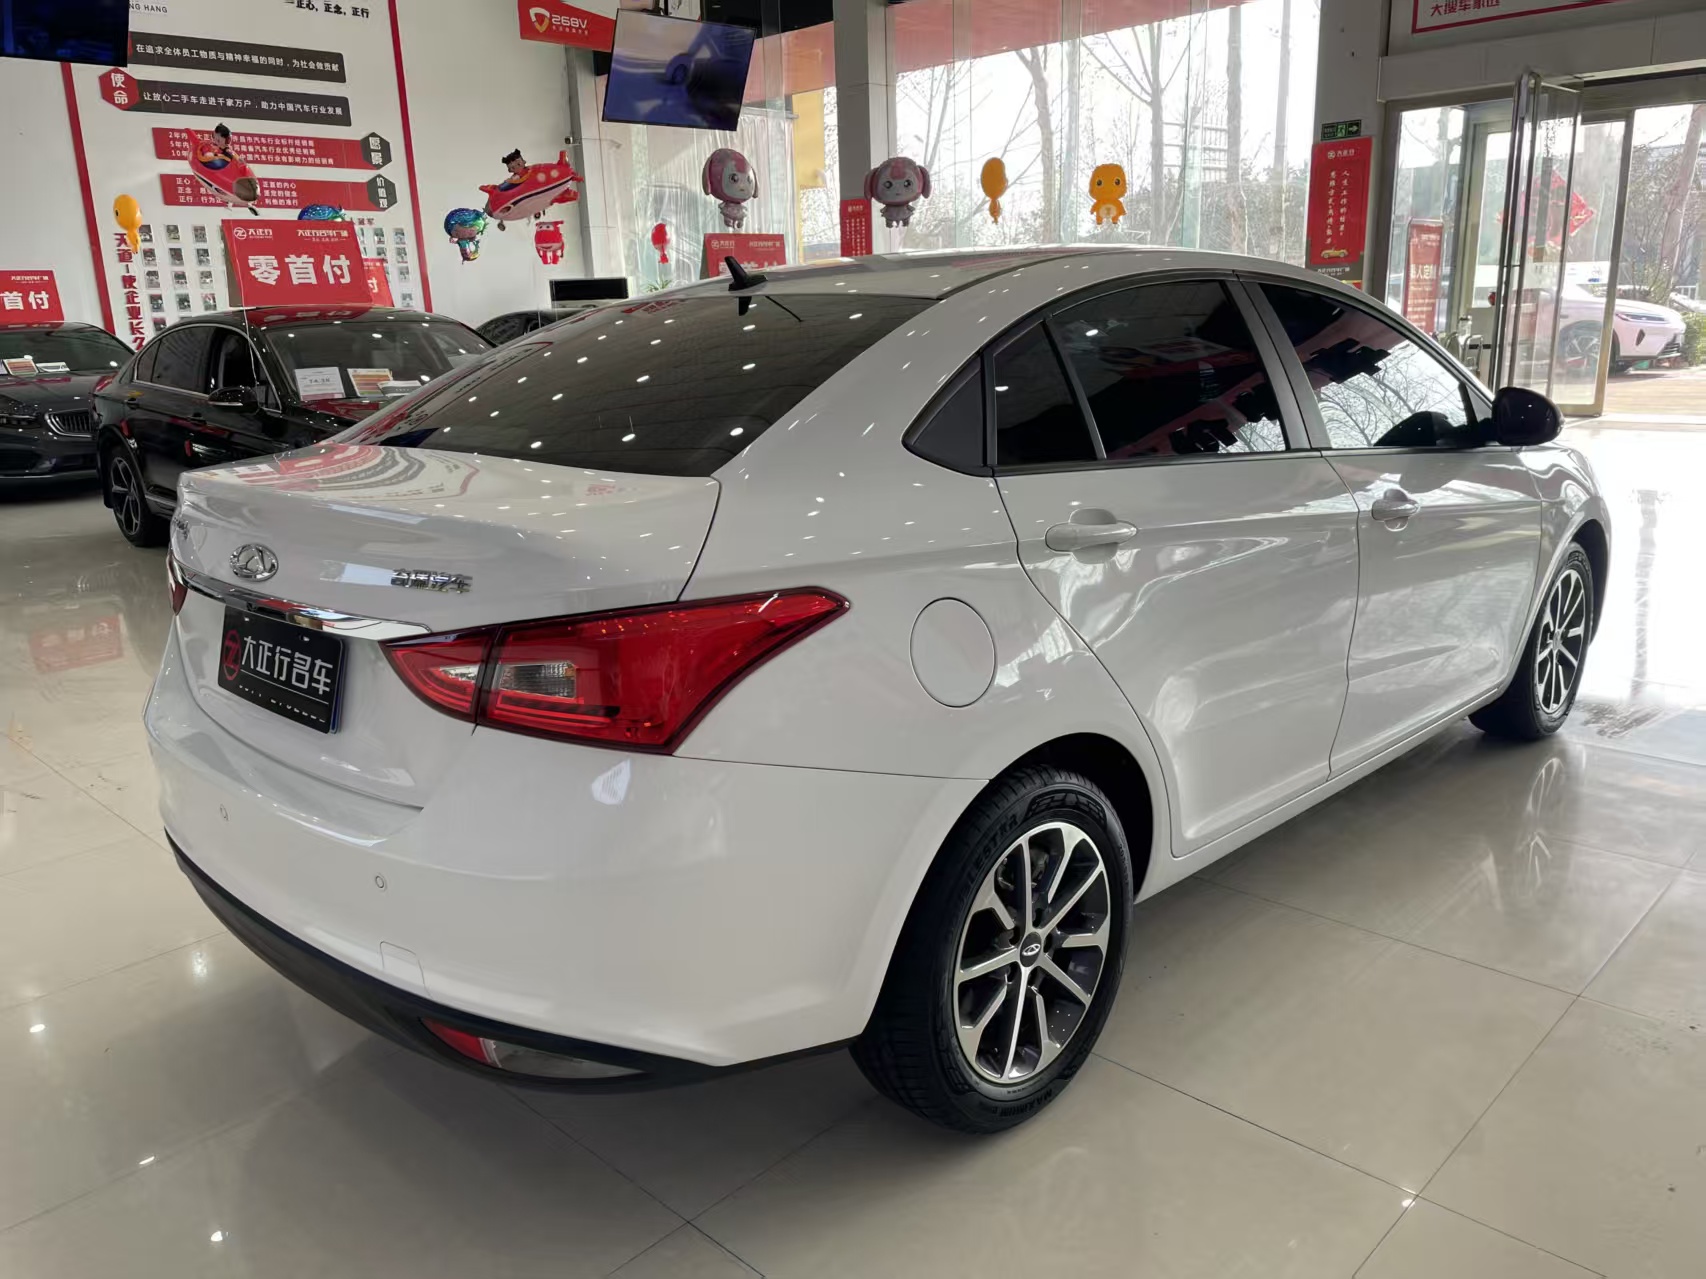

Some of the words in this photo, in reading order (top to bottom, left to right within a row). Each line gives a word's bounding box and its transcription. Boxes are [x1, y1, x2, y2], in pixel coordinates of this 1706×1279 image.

[143, 4, 168, 13] HANG
[551, 14, 587, 29] 268V
[110, 72, 129, 105] 使命
[247, 254, 351, 286] 零首付
[241, 635, 334, 695] 大正行名车
